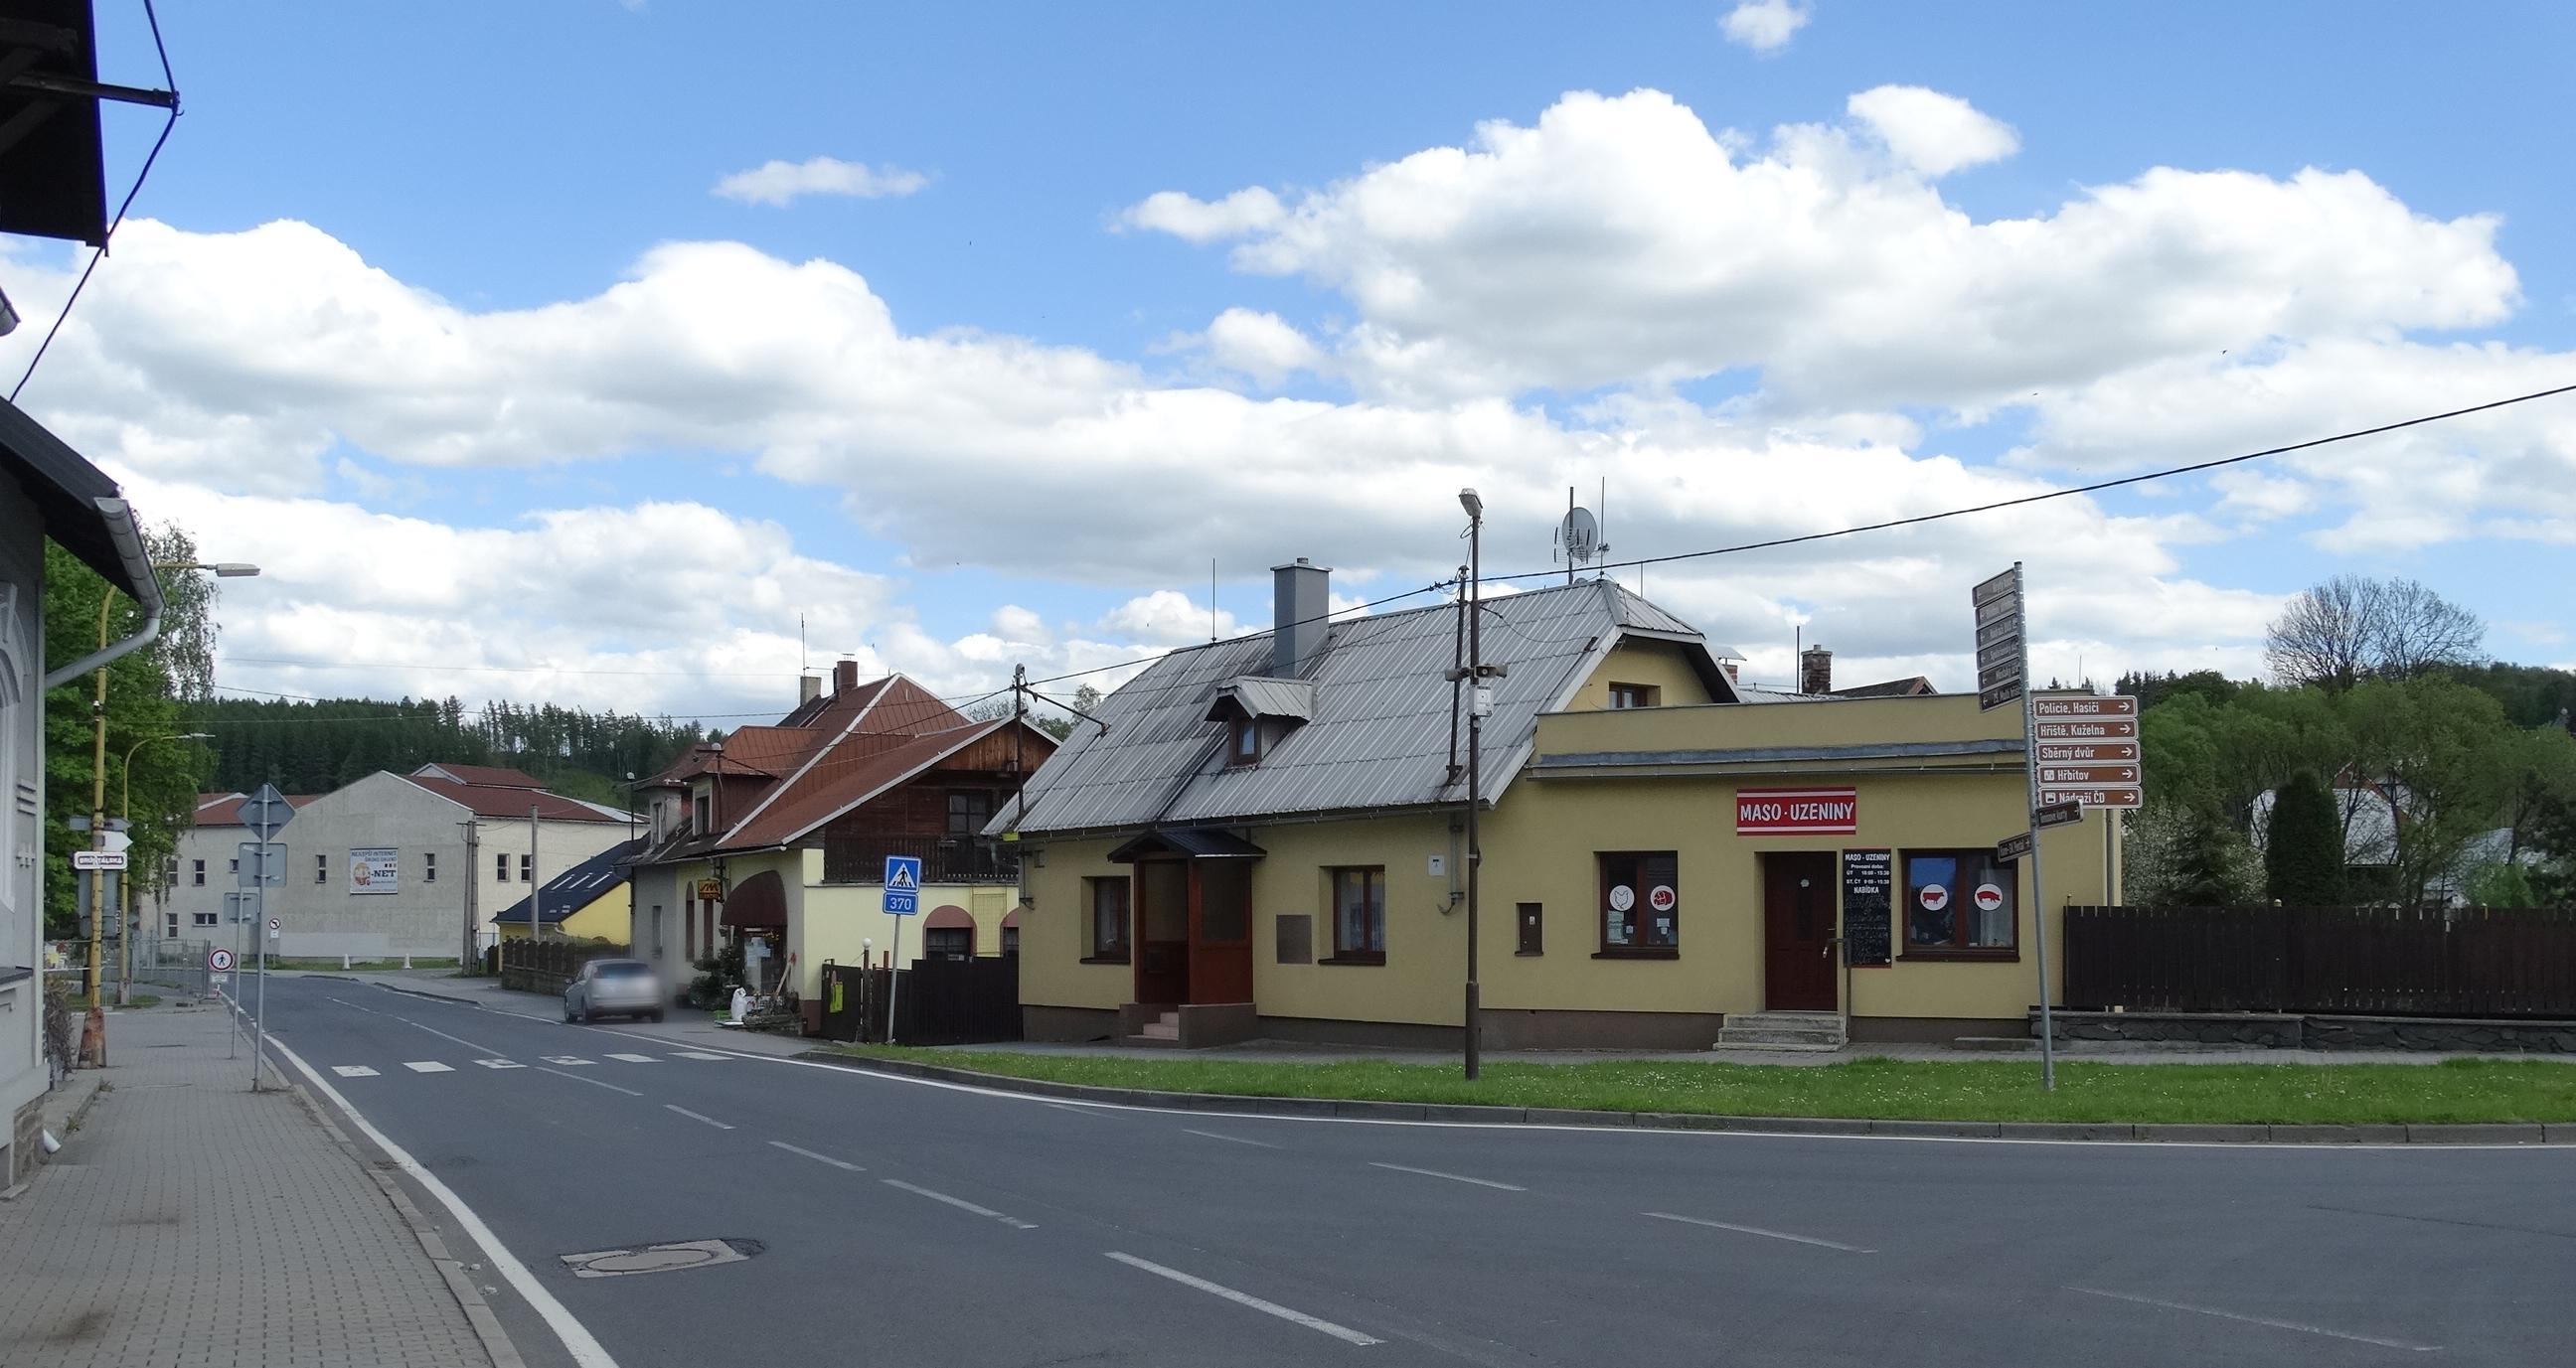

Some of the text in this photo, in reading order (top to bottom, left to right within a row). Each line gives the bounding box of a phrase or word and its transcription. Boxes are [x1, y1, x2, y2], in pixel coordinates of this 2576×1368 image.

[2073, 701, 2099, 713] Hasiči
[2070, 724, 2105, 736] Kuželna
[2042, 746, 2095, 761] Sběrný dvůr
[2057, 769, 2089, 781] Hřbitov
[2093, 790, 2105, 804] ČD
[1740, 803, 1782, 822] MASO
[1790, 802, 1854, 821] UZENINY
[1853, 885, 1879, 894] NABÍDKA
[889, 897, 912, 911] 370
